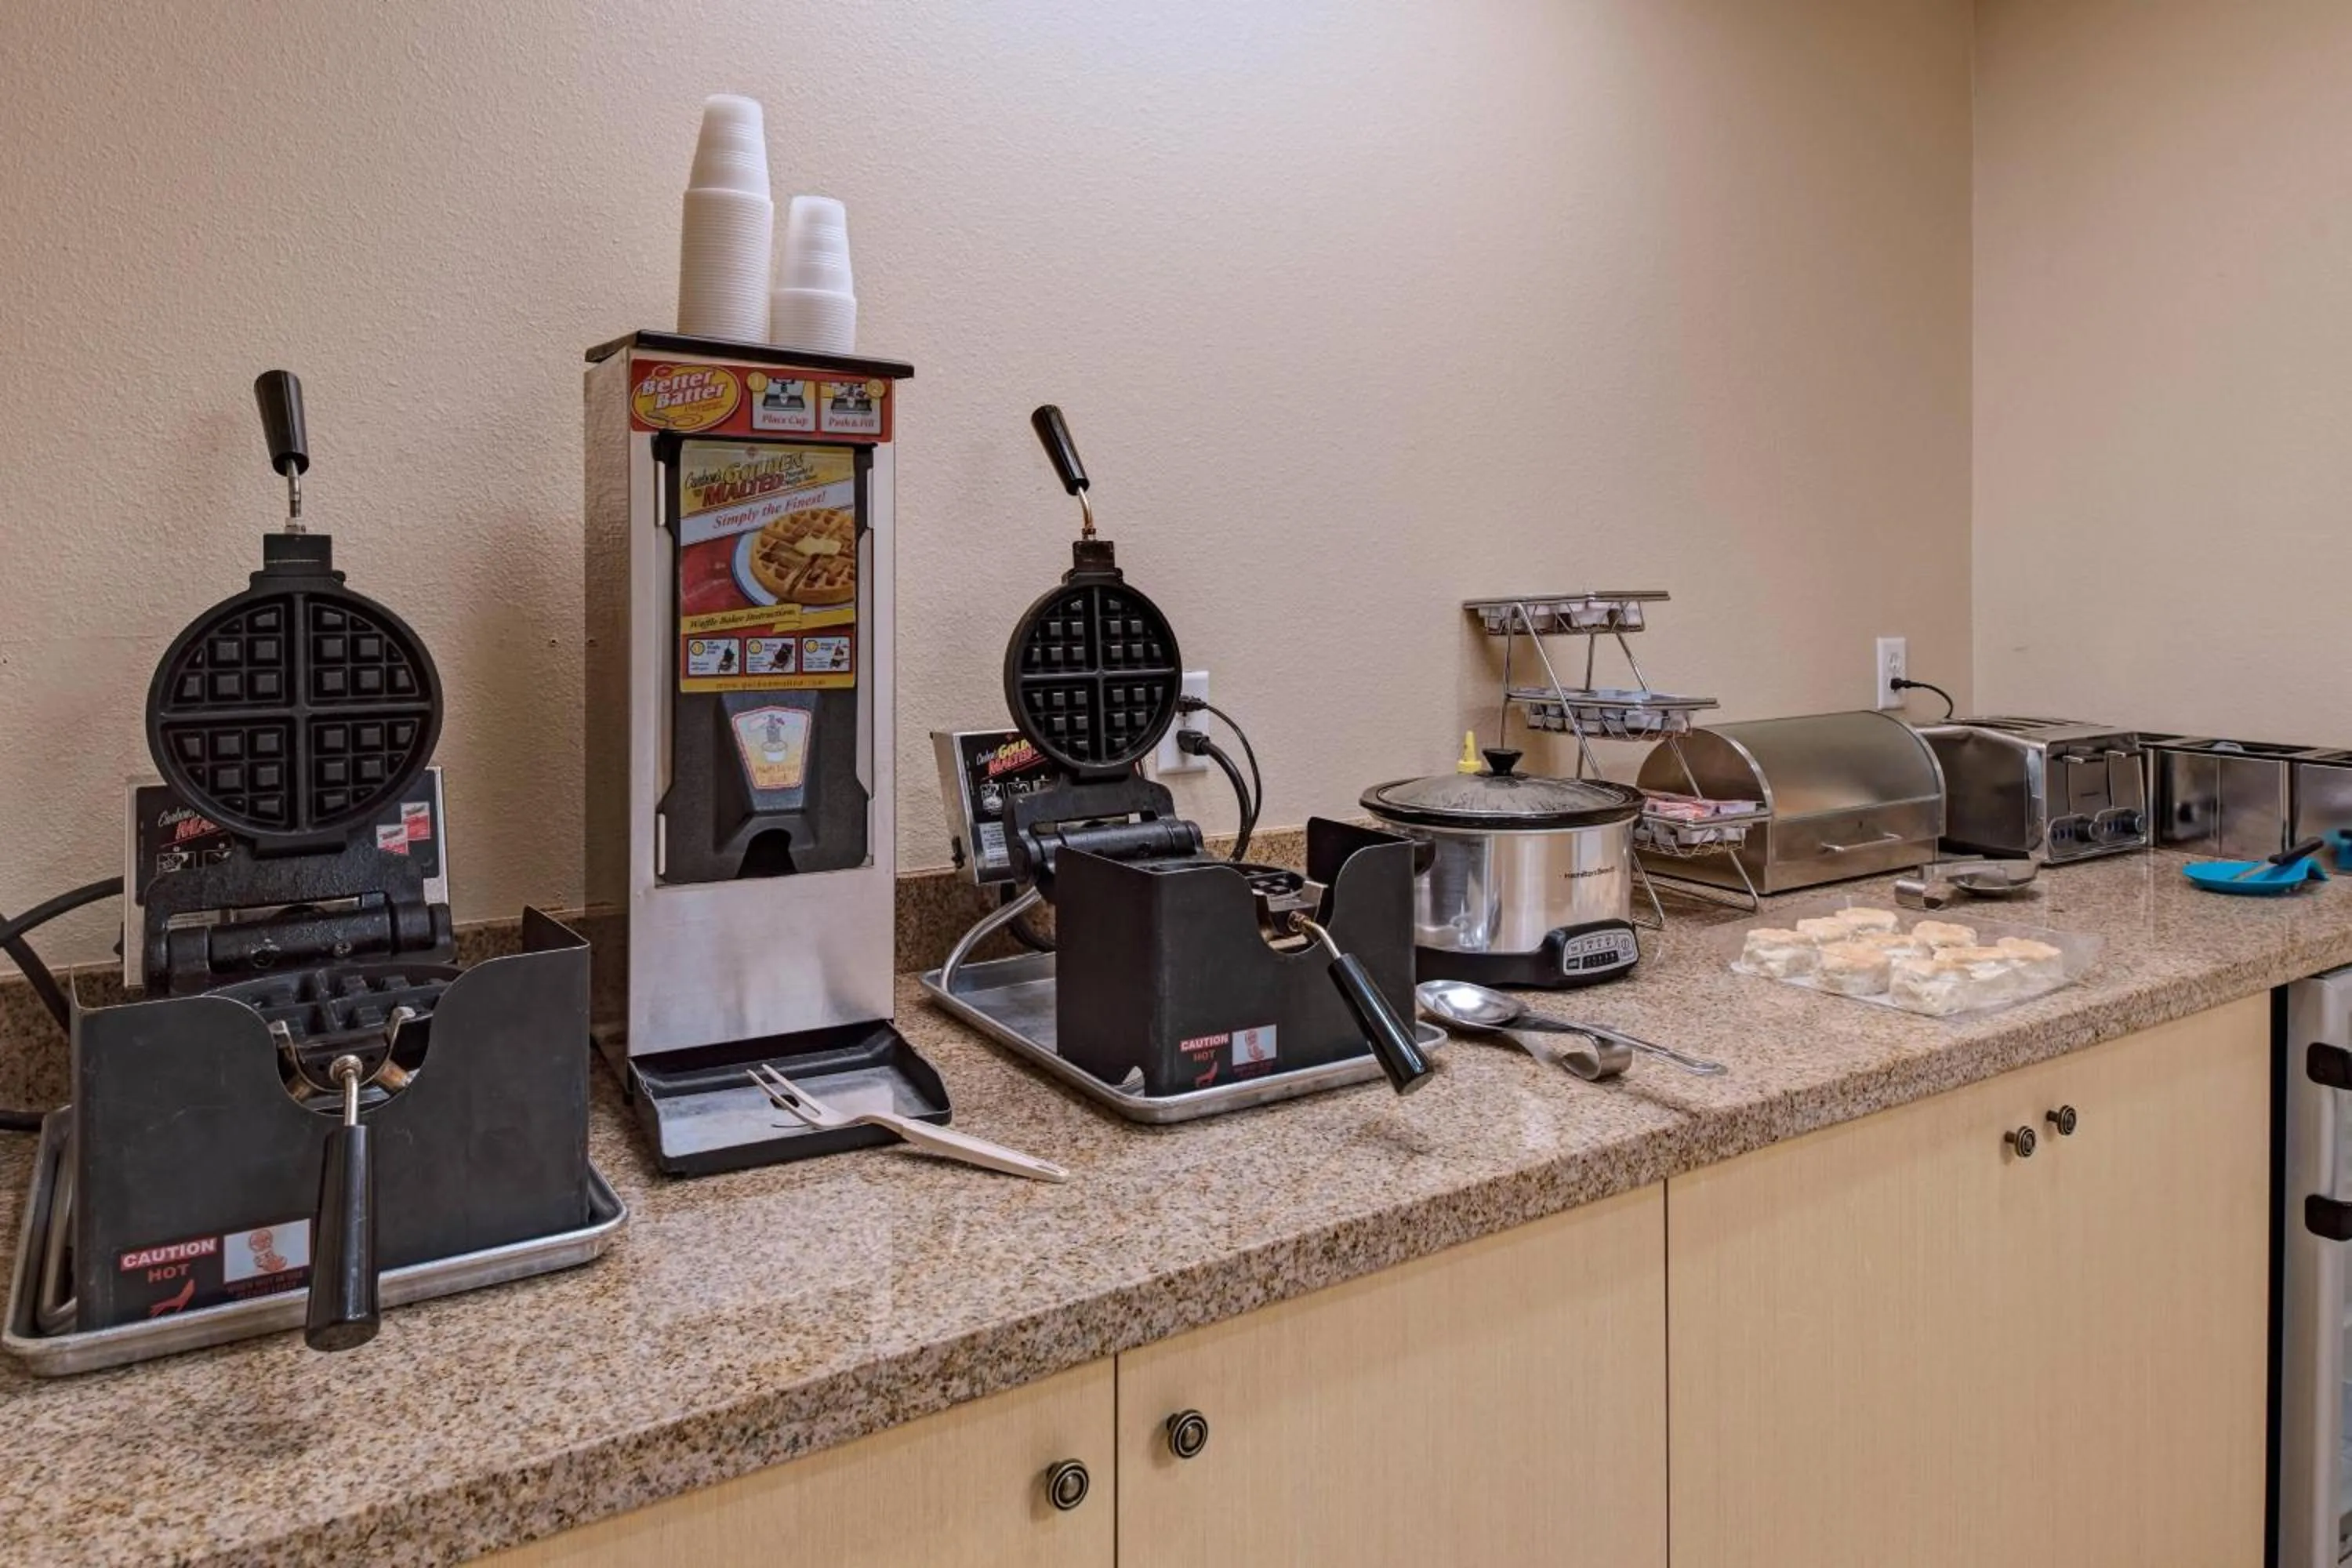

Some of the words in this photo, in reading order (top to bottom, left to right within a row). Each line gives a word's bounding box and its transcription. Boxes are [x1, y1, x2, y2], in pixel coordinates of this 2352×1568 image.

[641, 369, 714, 397] Better
[655, 383, 728, 409] Batter
[762, 412, 785, 424] Place
[787, 414, 809, 426] Cup
[713, 508, 759, 529] Simply
[762, 501, 782, 516] the
[785, 491, 828, 511] Finest!
[1181, 1033, 1229, 1051] CAUTION
[1193, 1050, 1216, 1062] HOT
[123, 1238, 217, 1269] CAUTION
[147, 1263, 191, 1283] HOT
